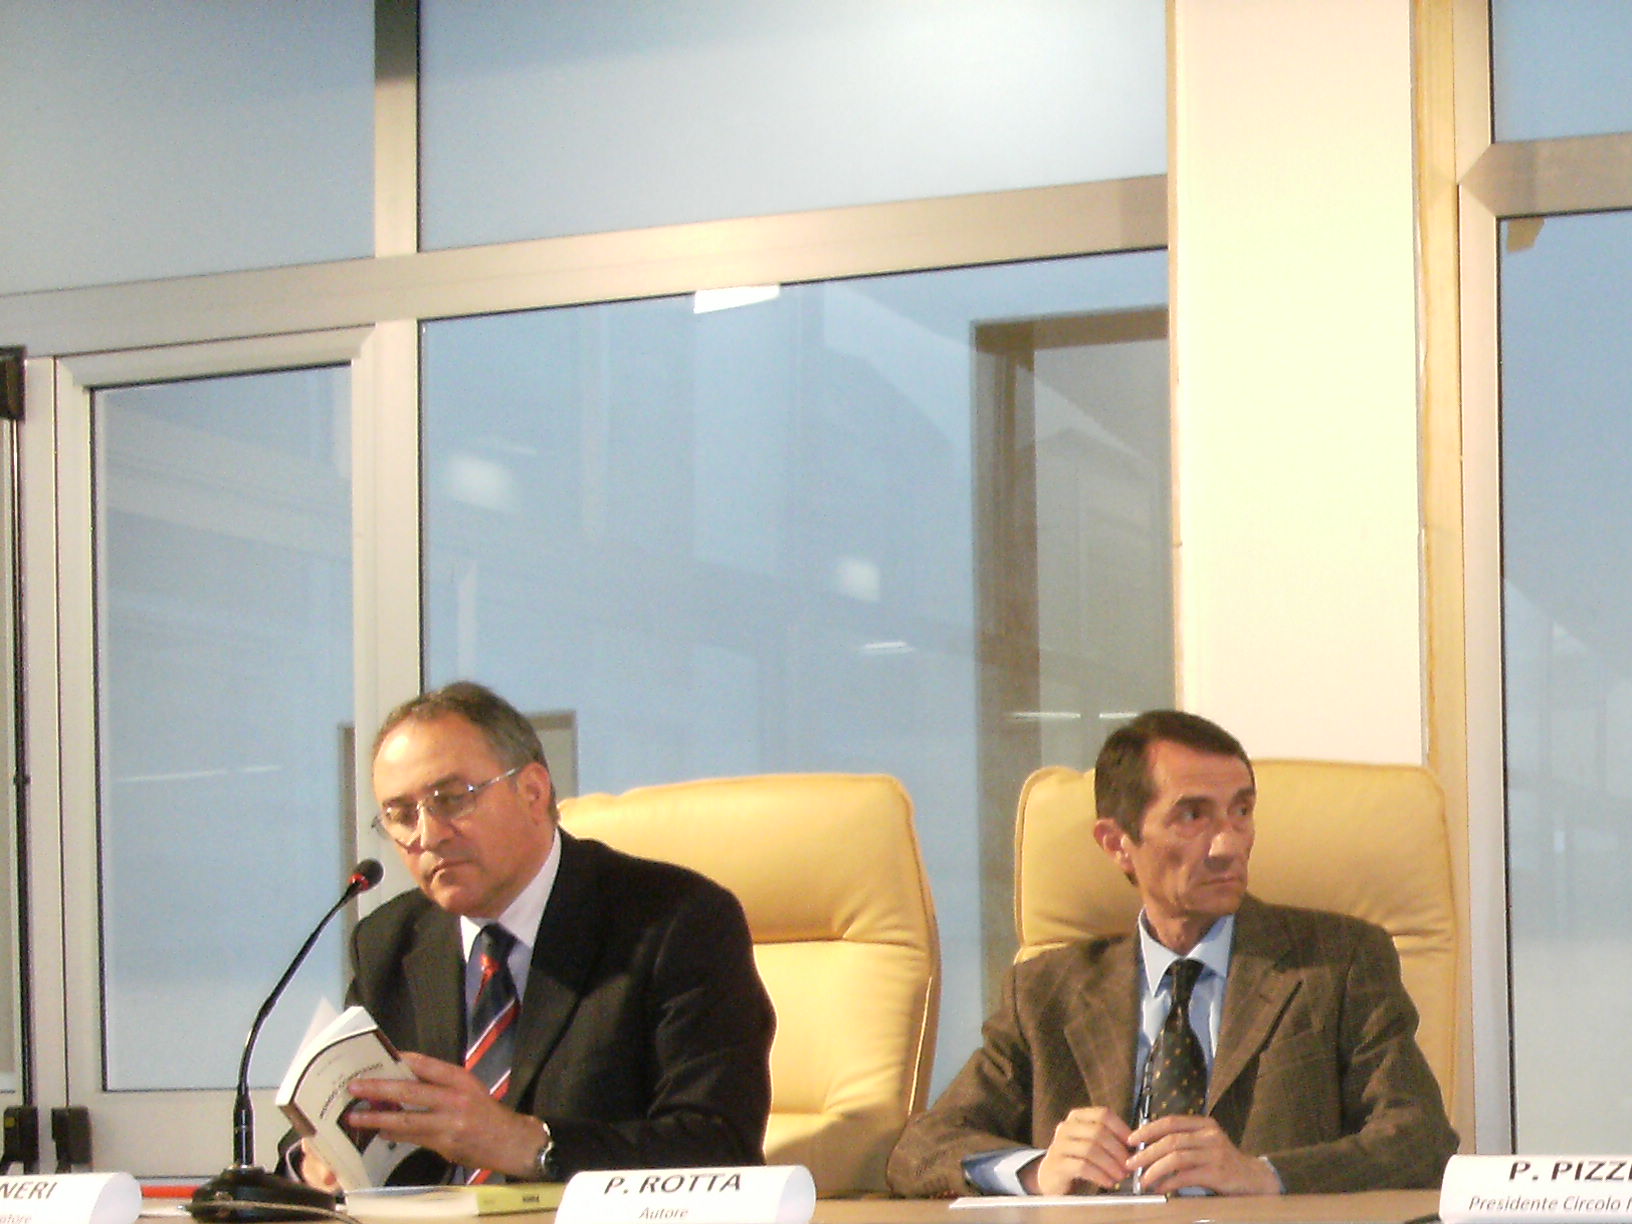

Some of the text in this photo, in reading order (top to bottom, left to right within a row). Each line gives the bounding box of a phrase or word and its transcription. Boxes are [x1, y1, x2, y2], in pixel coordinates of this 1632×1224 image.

[1509, 1160, 1539, 1181] P.
[604, 1172, 741, 1195] P. ROTTA
[1468, 1195, 1558, 1211] Presidente
[1563, 1195, 1621, 1211] Circolo
[639, 1206, 689, 1220] Autore
